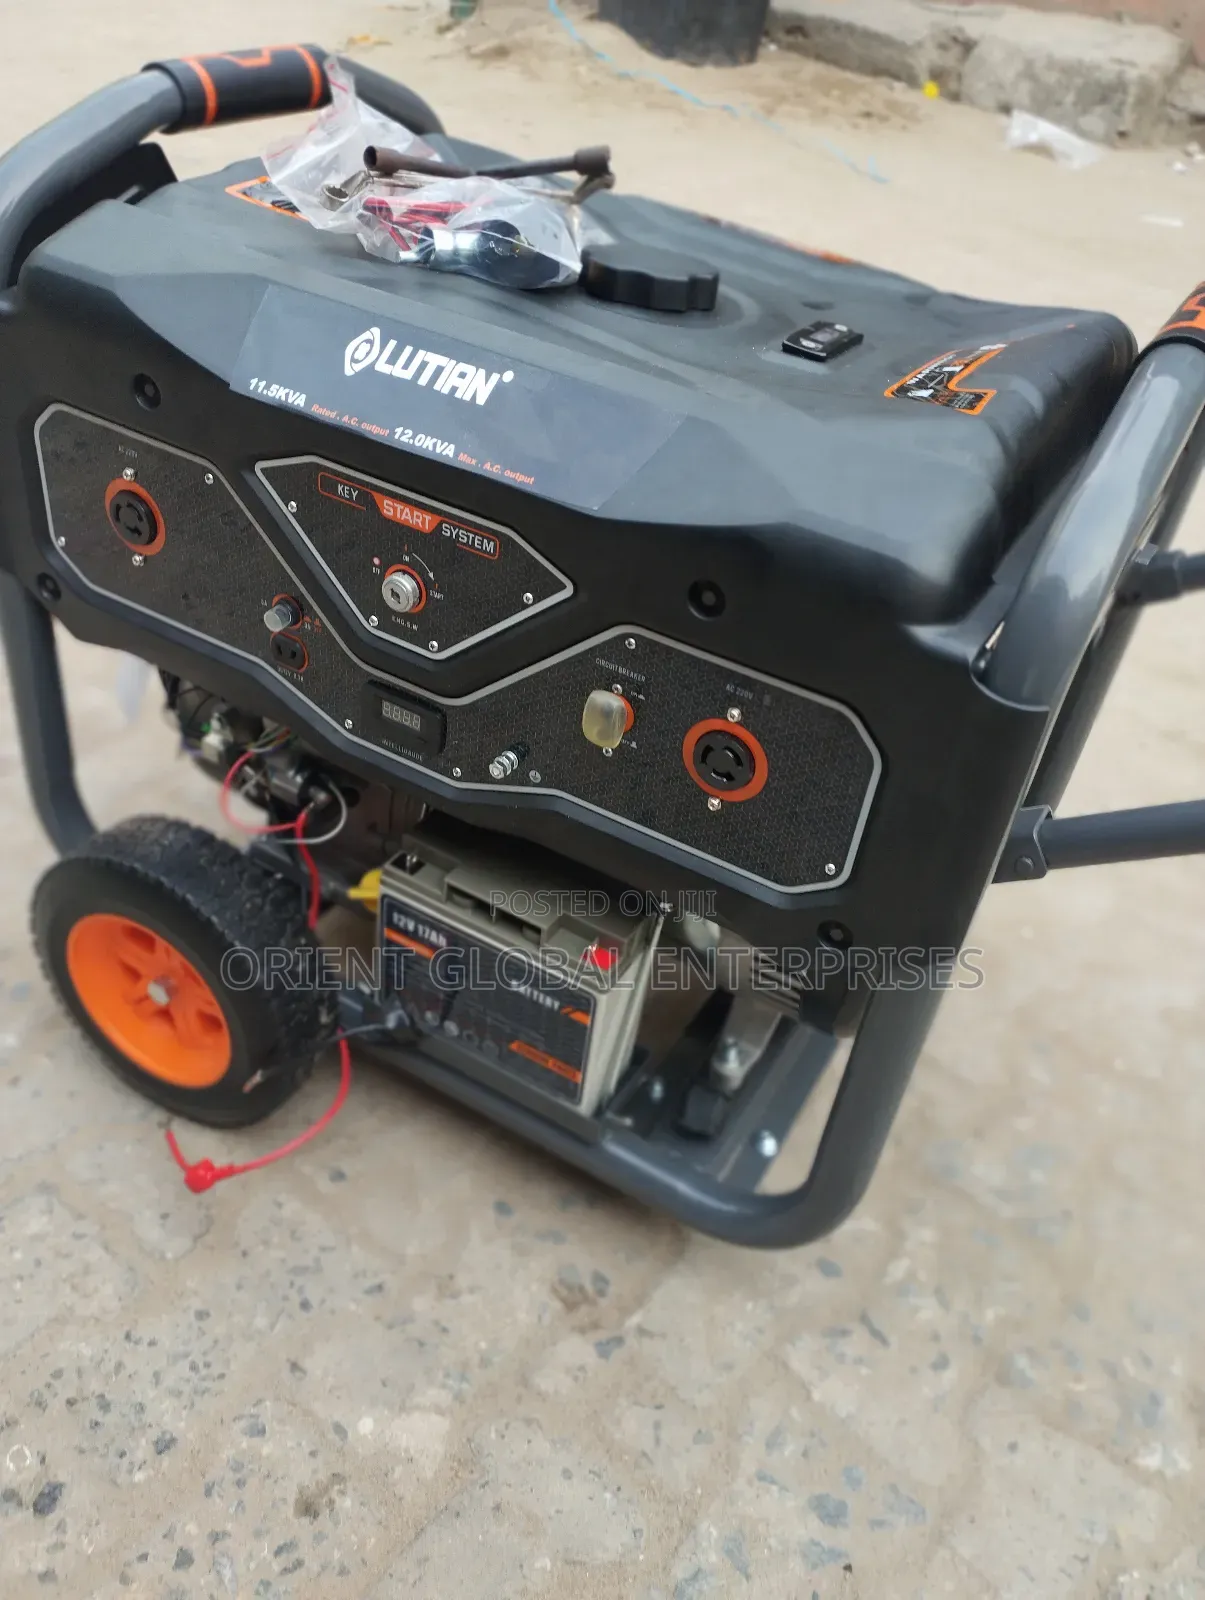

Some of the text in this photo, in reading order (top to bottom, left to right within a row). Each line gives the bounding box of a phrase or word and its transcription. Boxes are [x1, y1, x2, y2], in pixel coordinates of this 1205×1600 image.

[374, 339, 500, 406] LUTIAN
[248, 377, 535, 485] 11.5KVA Rated A.C. output 12.0KVA Max A.C. output
[337, 483, 495, 554] KEY START SYSTEM
